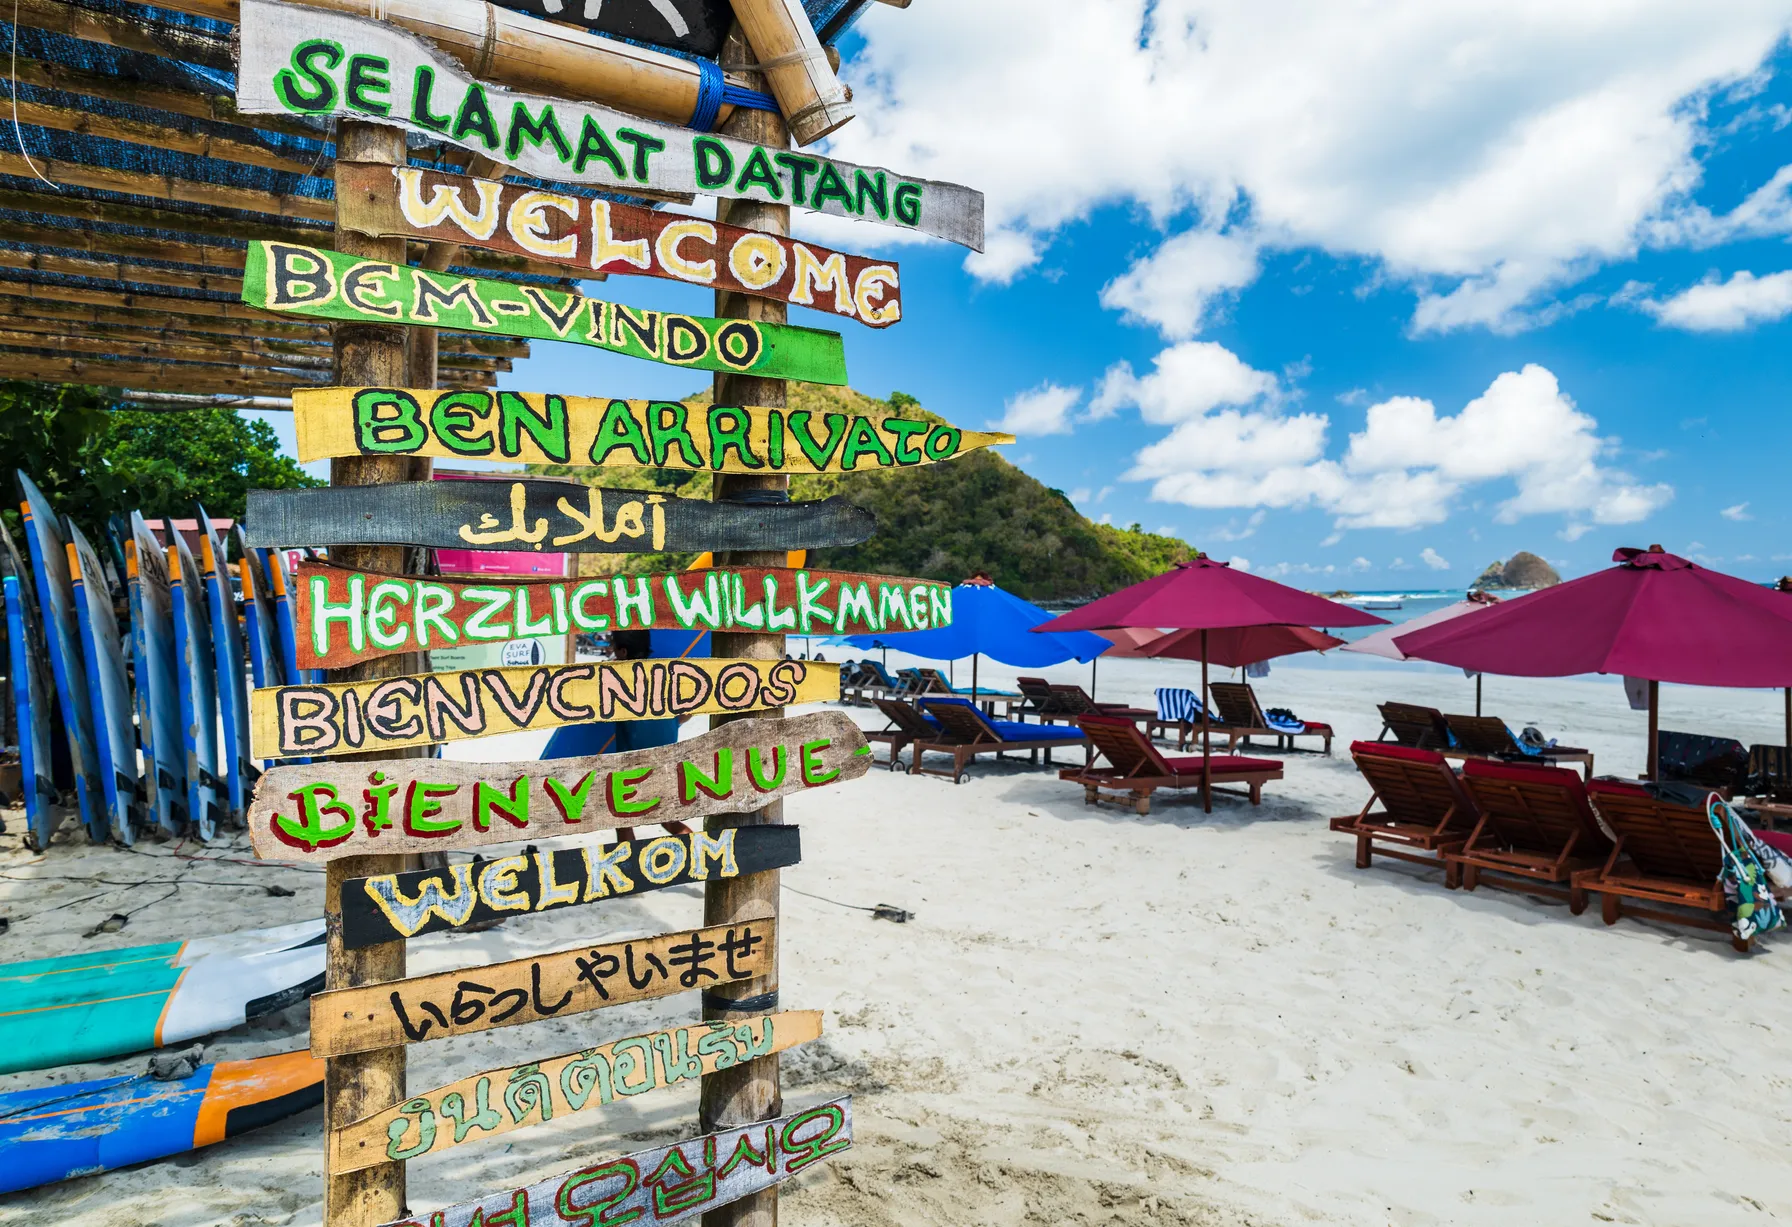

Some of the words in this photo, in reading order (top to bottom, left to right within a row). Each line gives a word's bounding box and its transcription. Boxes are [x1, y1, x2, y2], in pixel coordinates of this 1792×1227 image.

[273, 38, 666, 183] SELAMAT
[693, 135, 923, 227] DATANG
[261, 240, 763, 371] BEM-VINDO
[392, 166, 901, 325] WELCOME
[309, 572, 655, 658] HERZLICH
[662, 570, 954, 635] WILLKMMEN
[506, 650, 531, 659] SURF
[363, 827, 740, 938] WELKOM
